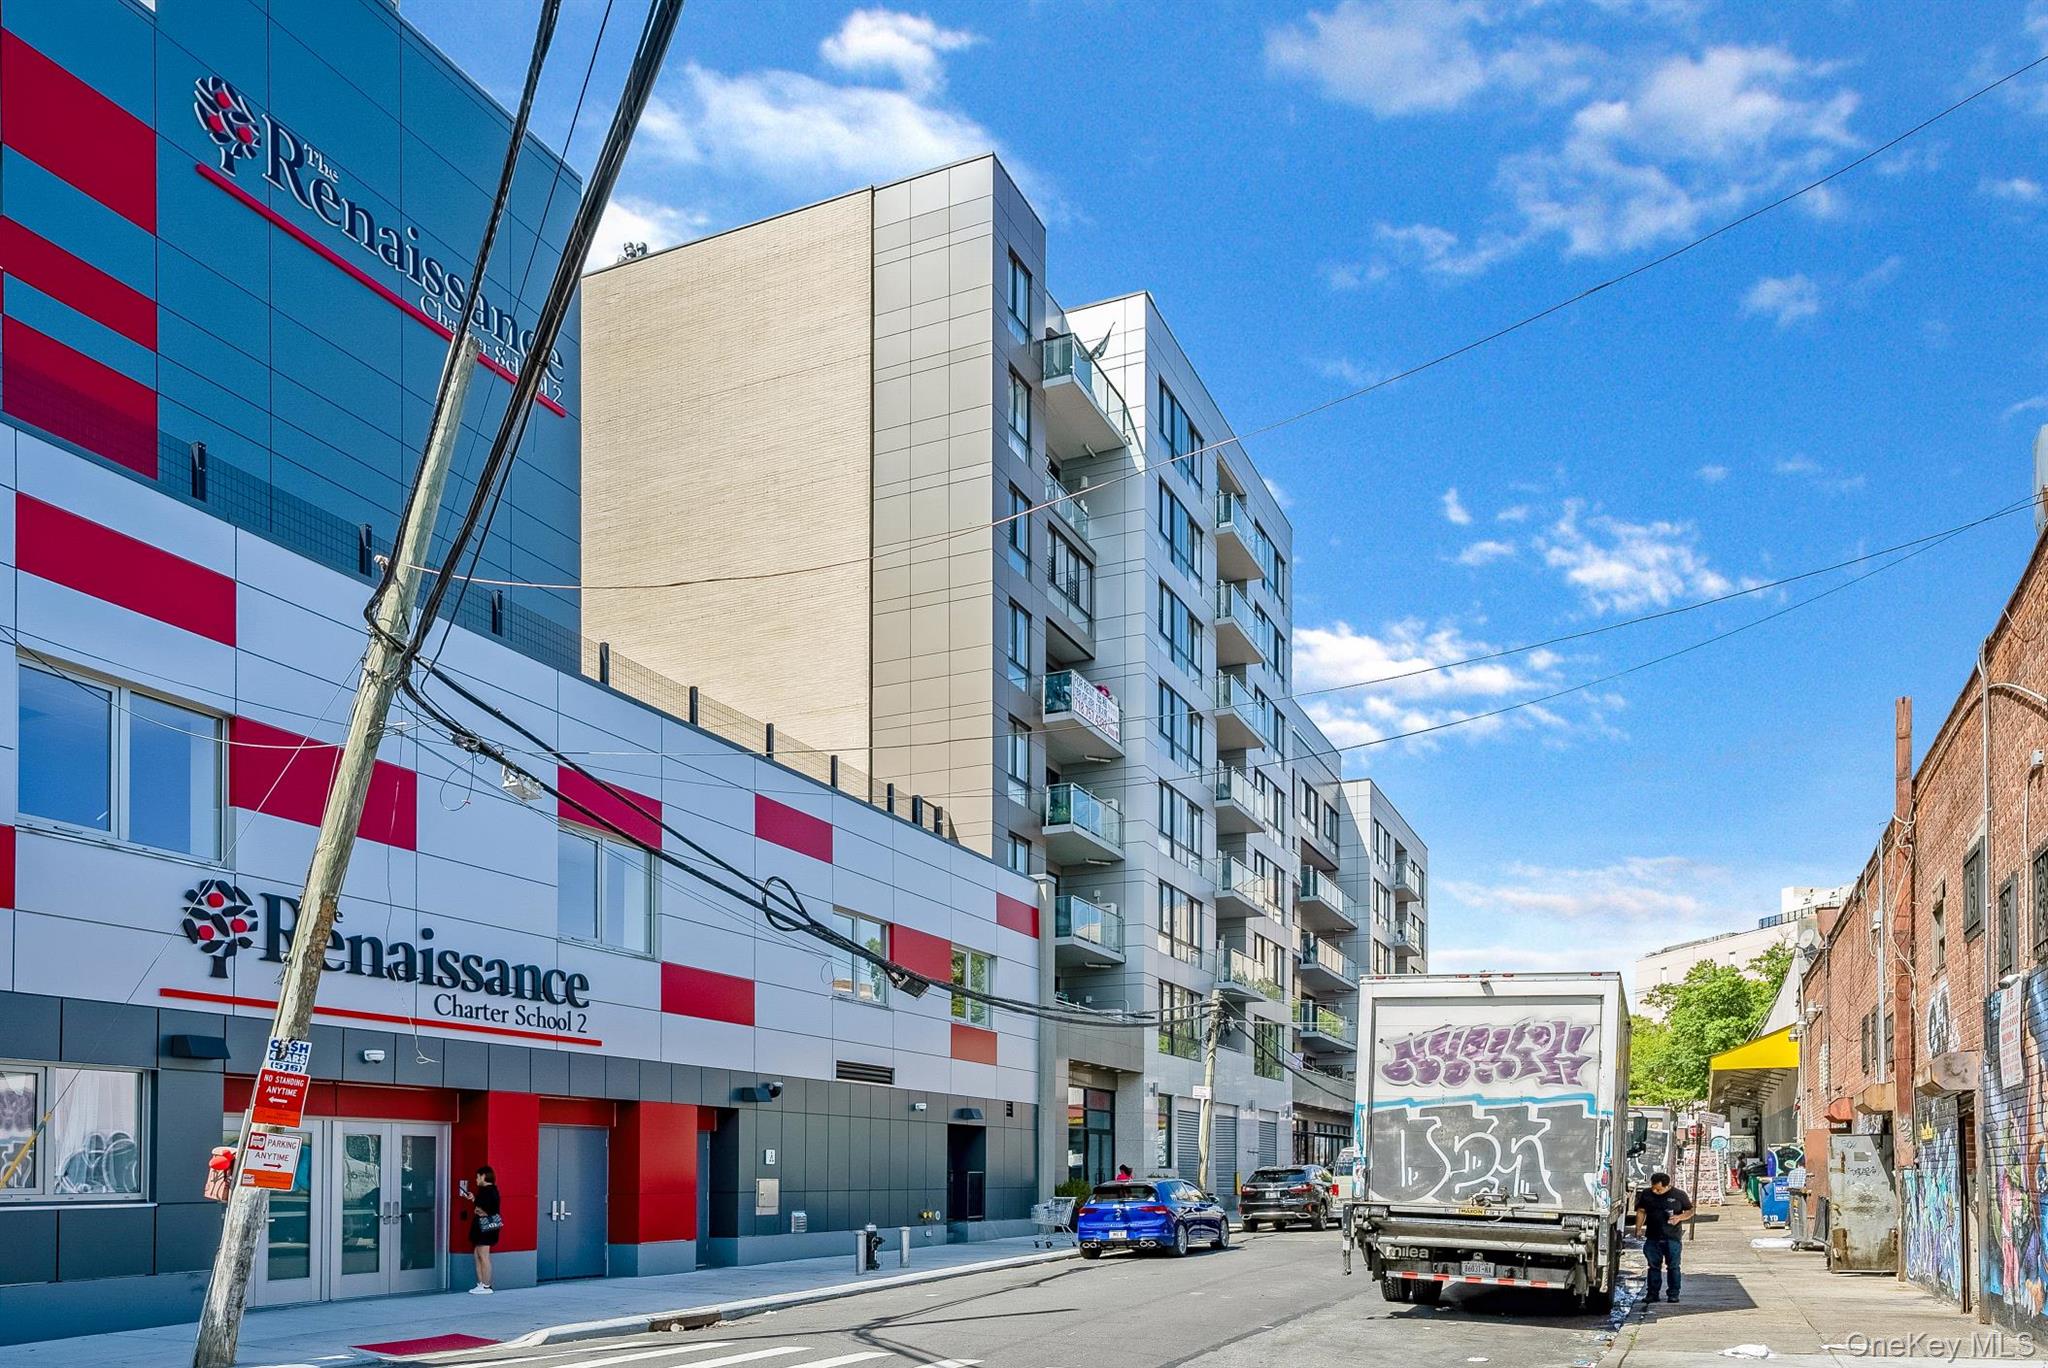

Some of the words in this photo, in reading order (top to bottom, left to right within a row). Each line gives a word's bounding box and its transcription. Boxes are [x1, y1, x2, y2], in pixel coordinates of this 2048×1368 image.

[303, 142, 340, 184] The
[261, 113, 565, 384] Renaissance
[420, 296, 491, 353] Chaer
[552, 384, 563, 404] 2
[259, 891, 590, 1009] Renaissance
[433, 993, 509, 1024] Charter
[515, 1005, 572, 1032] School
[577, 1014, 588, 1034] 2
[264, 1074, 273, 1083] NO
[275, 1075, 304, 1087] STANDING
[266, 1085, 298, 1097] ANYTIME
[255, 1151, 289, 1162] ANYTIME
[267, 1139, 297, 1150] PARKING
[1385, 1246, 1429, 1259] milea
